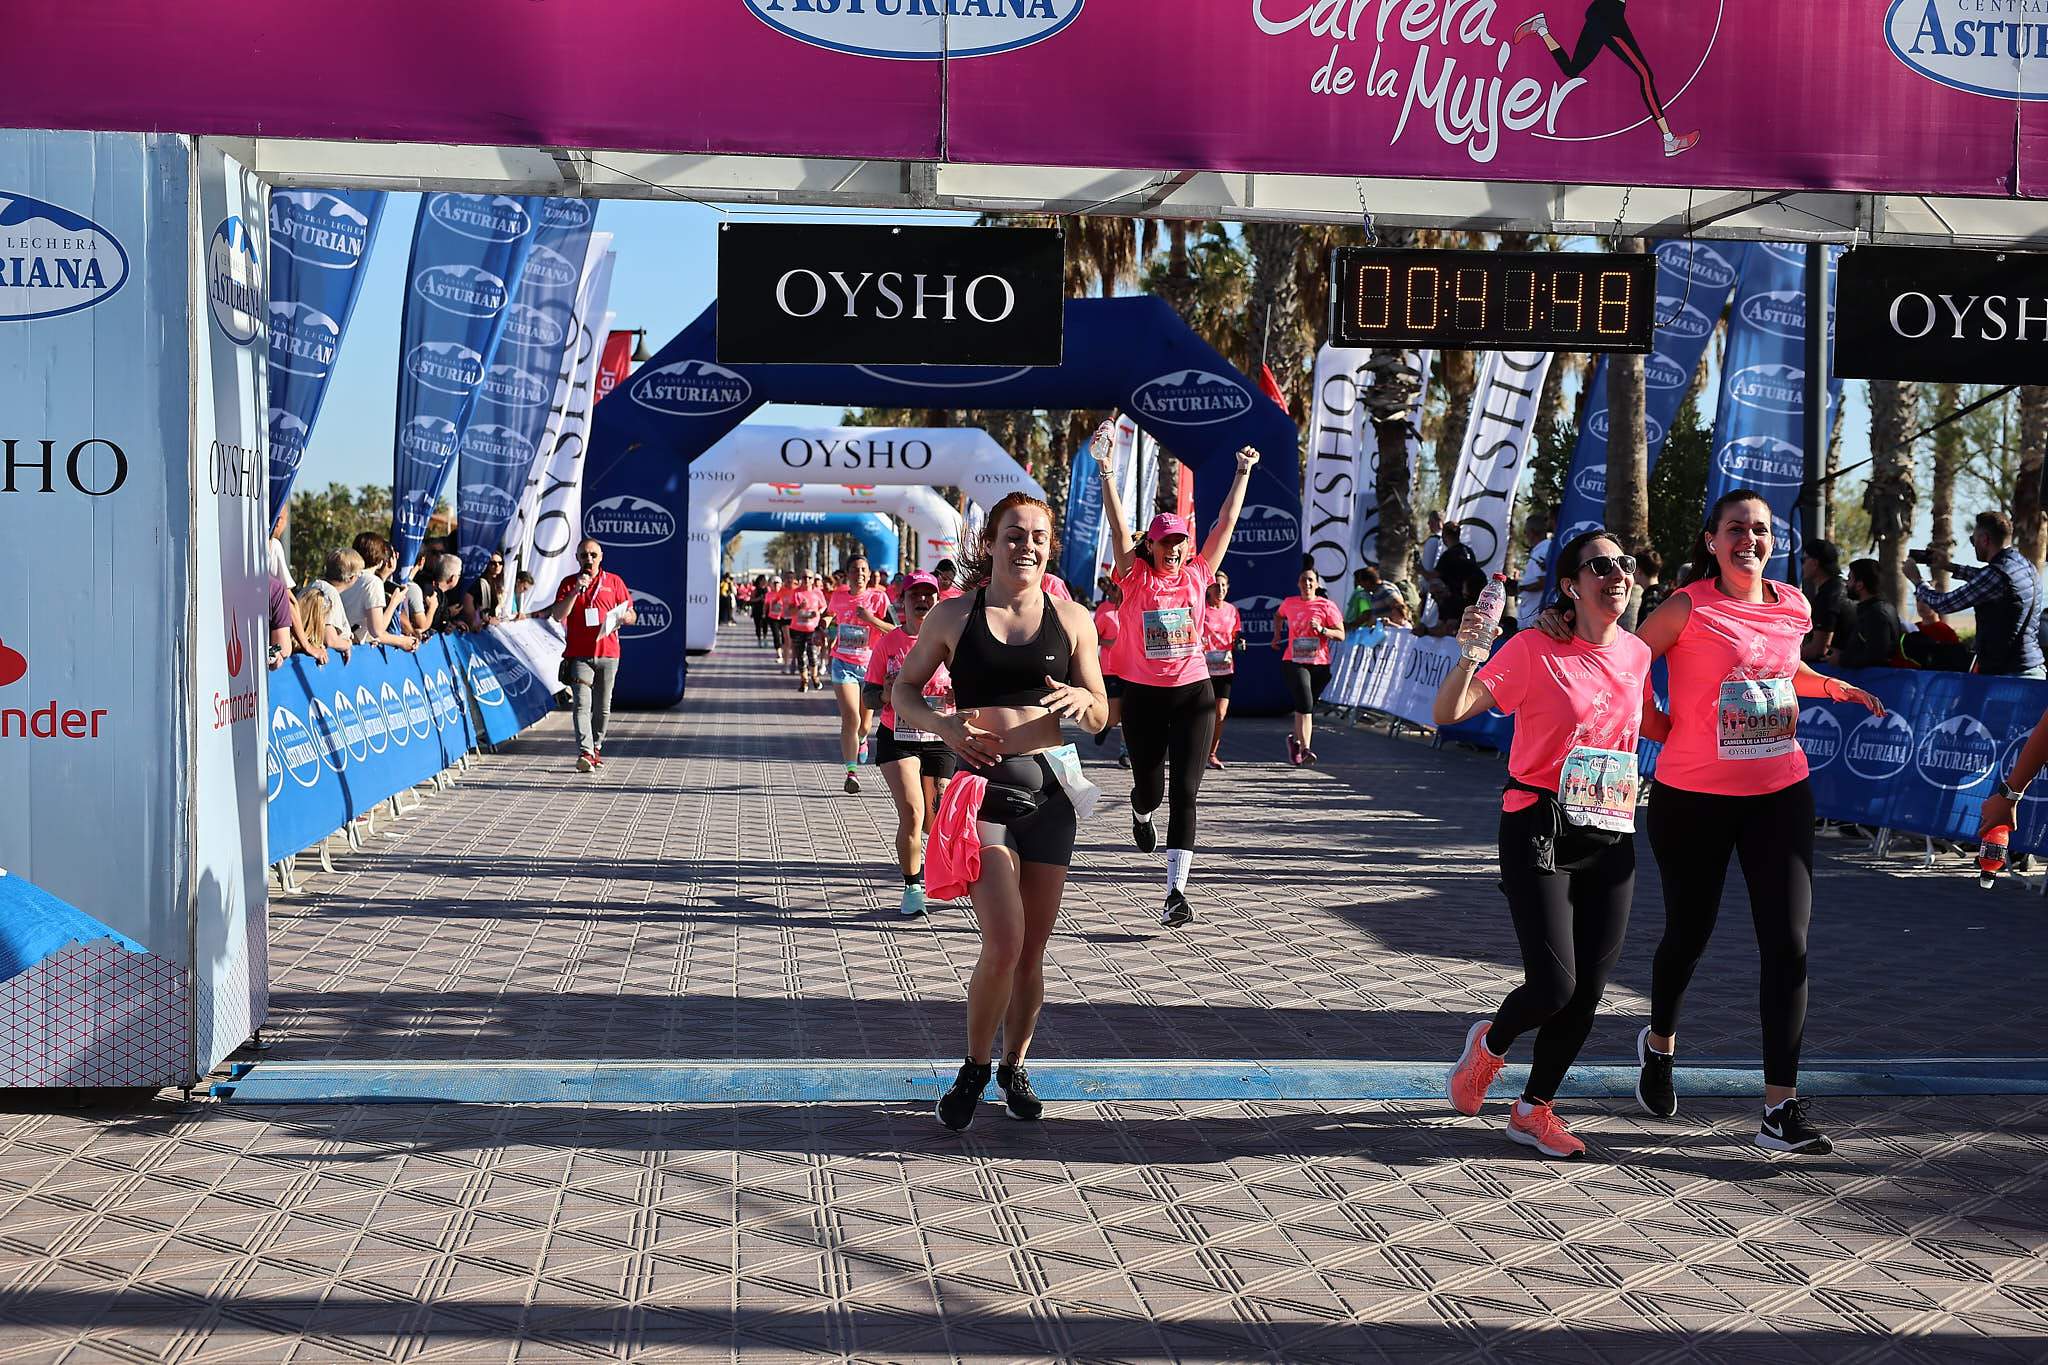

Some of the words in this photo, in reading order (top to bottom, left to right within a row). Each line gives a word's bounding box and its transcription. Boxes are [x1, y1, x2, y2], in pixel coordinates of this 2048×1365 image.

[1959, 0, 2048, 12] CENTRA
[1311, 44, 1355, 95] de
[1366, 44, 1399, 98] la
[1390, 41, 1588, 163] Mujer
[7, 237, 97, 250] LECHERA
[775, 269, 1015, 323] OYSHO
[1358, 265, 1631, 334] 00:41:48
[637, 380, 742, 403] ASTURIANA
[1142, 392, 1246, 412] ASTURIANA
[780, 437, 932, 470] OYSHO
[1724, 449, 1804, 479] ASTURIAN
[209, 440, 262, 500] OYSHO
[688, 470, 735, 482] OYSHO
[975, 472, 1020, 484] OYSHO
[587, 514, 670, 535] ASTURIANA
[1848, 734, 1906, 764] ASTURIANA
[1920, 735, 1988, 774] ASTURIANA
